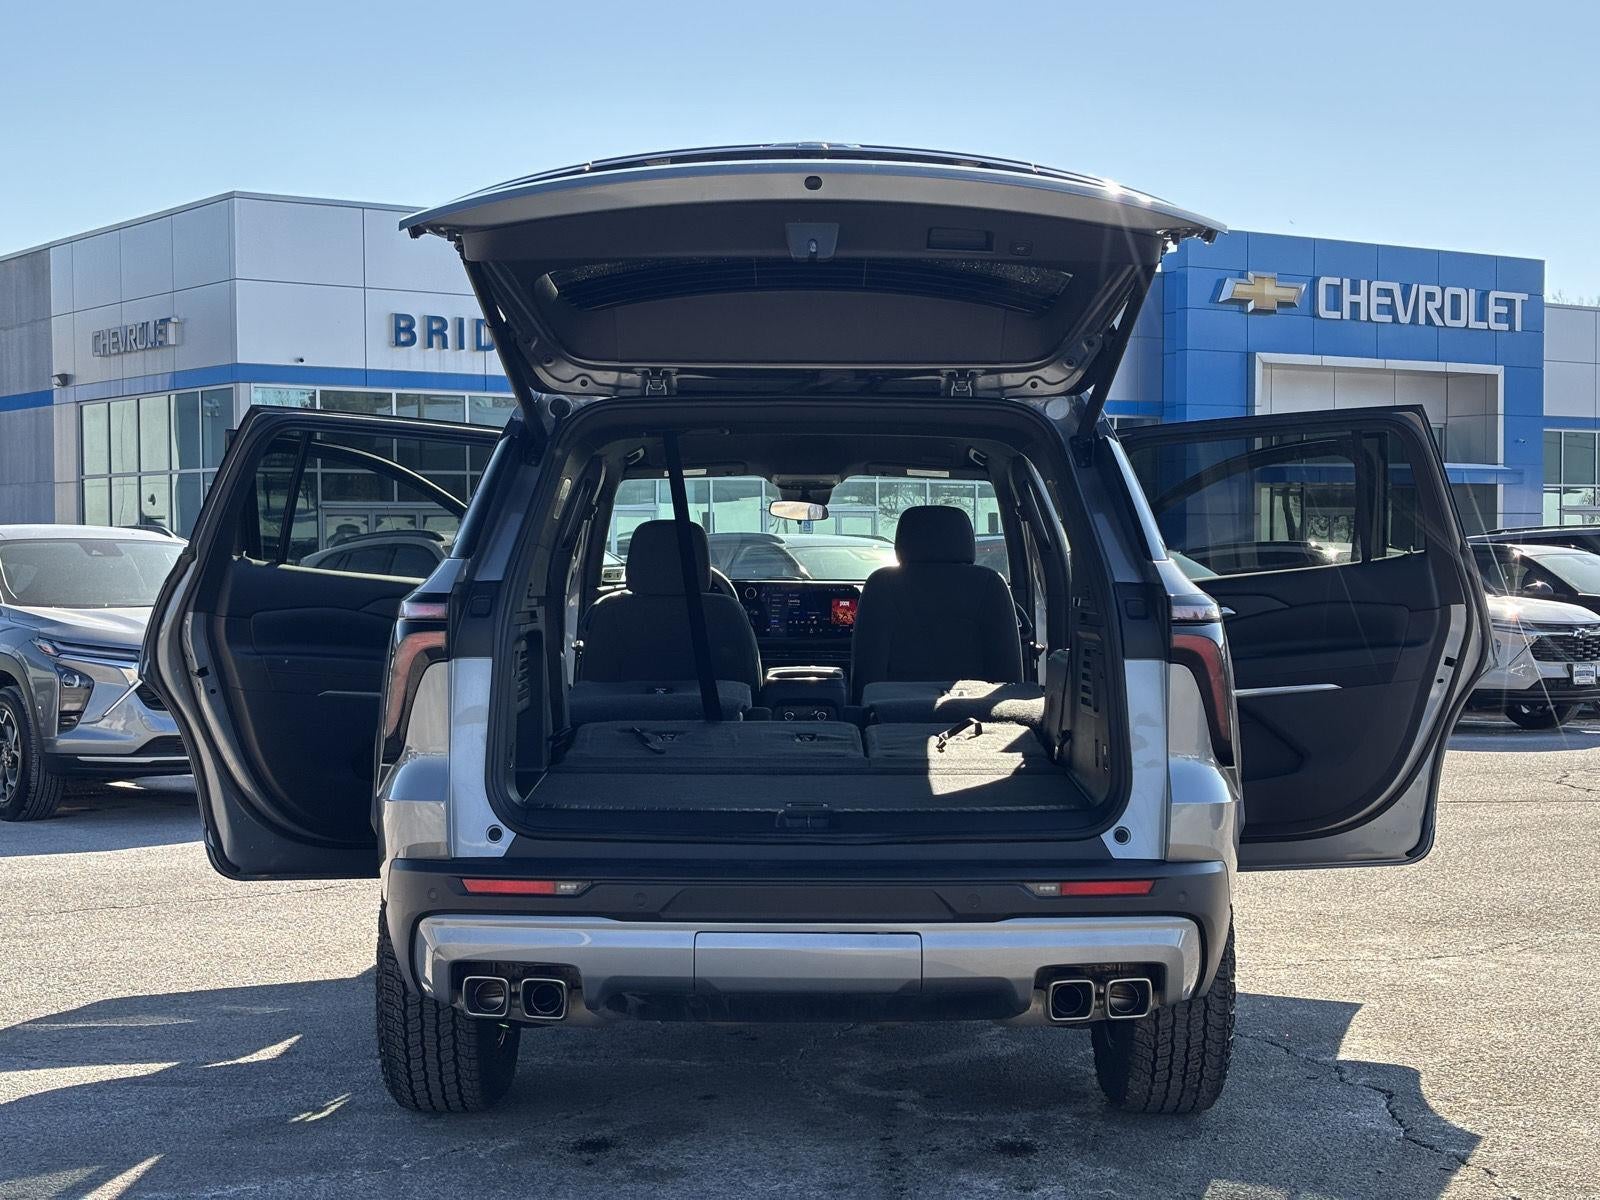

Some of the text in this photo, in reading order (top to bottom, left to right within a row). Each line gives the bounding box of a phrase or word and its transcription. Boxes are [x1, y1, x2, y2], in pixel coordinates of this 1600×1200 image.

[1318, 276, 1529, 332] CHEVROLET
[92, 317, 180, 357] CHEVROLET
[391, 313, 496, 351] BRID
